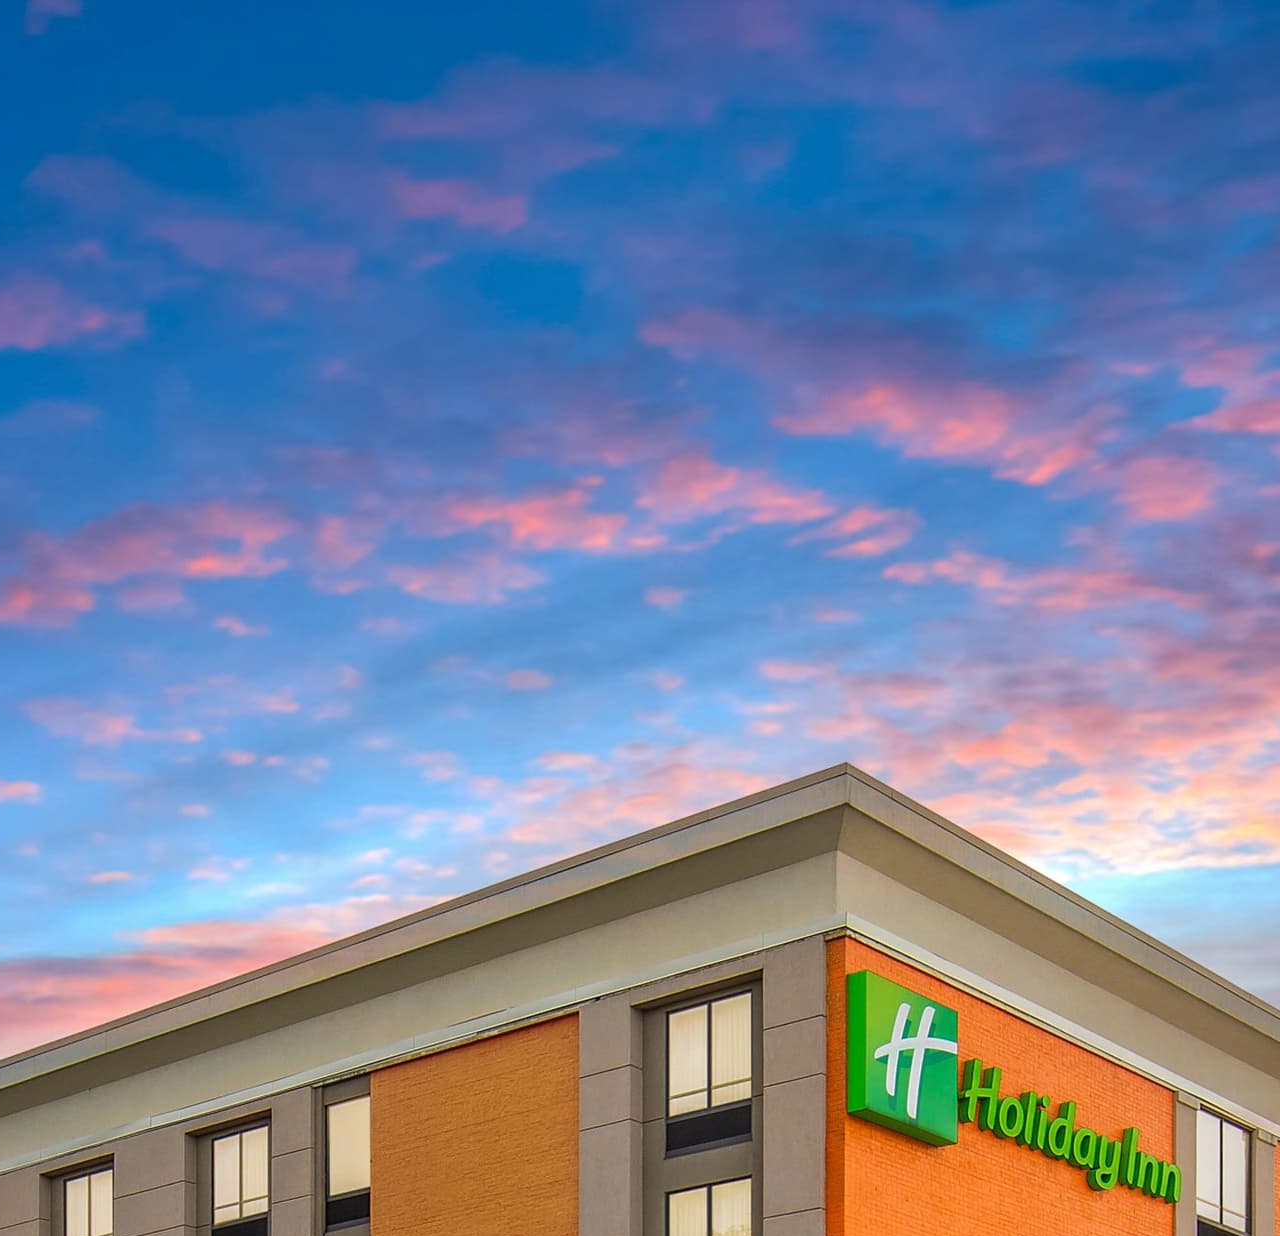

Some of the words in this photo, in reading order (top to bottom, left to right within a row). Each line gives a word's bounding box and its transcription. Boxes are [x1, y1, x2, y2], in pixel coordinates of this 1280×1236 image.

[873, 1002, 958, 1120] H
[958, 1058, 1122, 1191] Holiday
[1122, 1127, 1182, 1203] Inn
